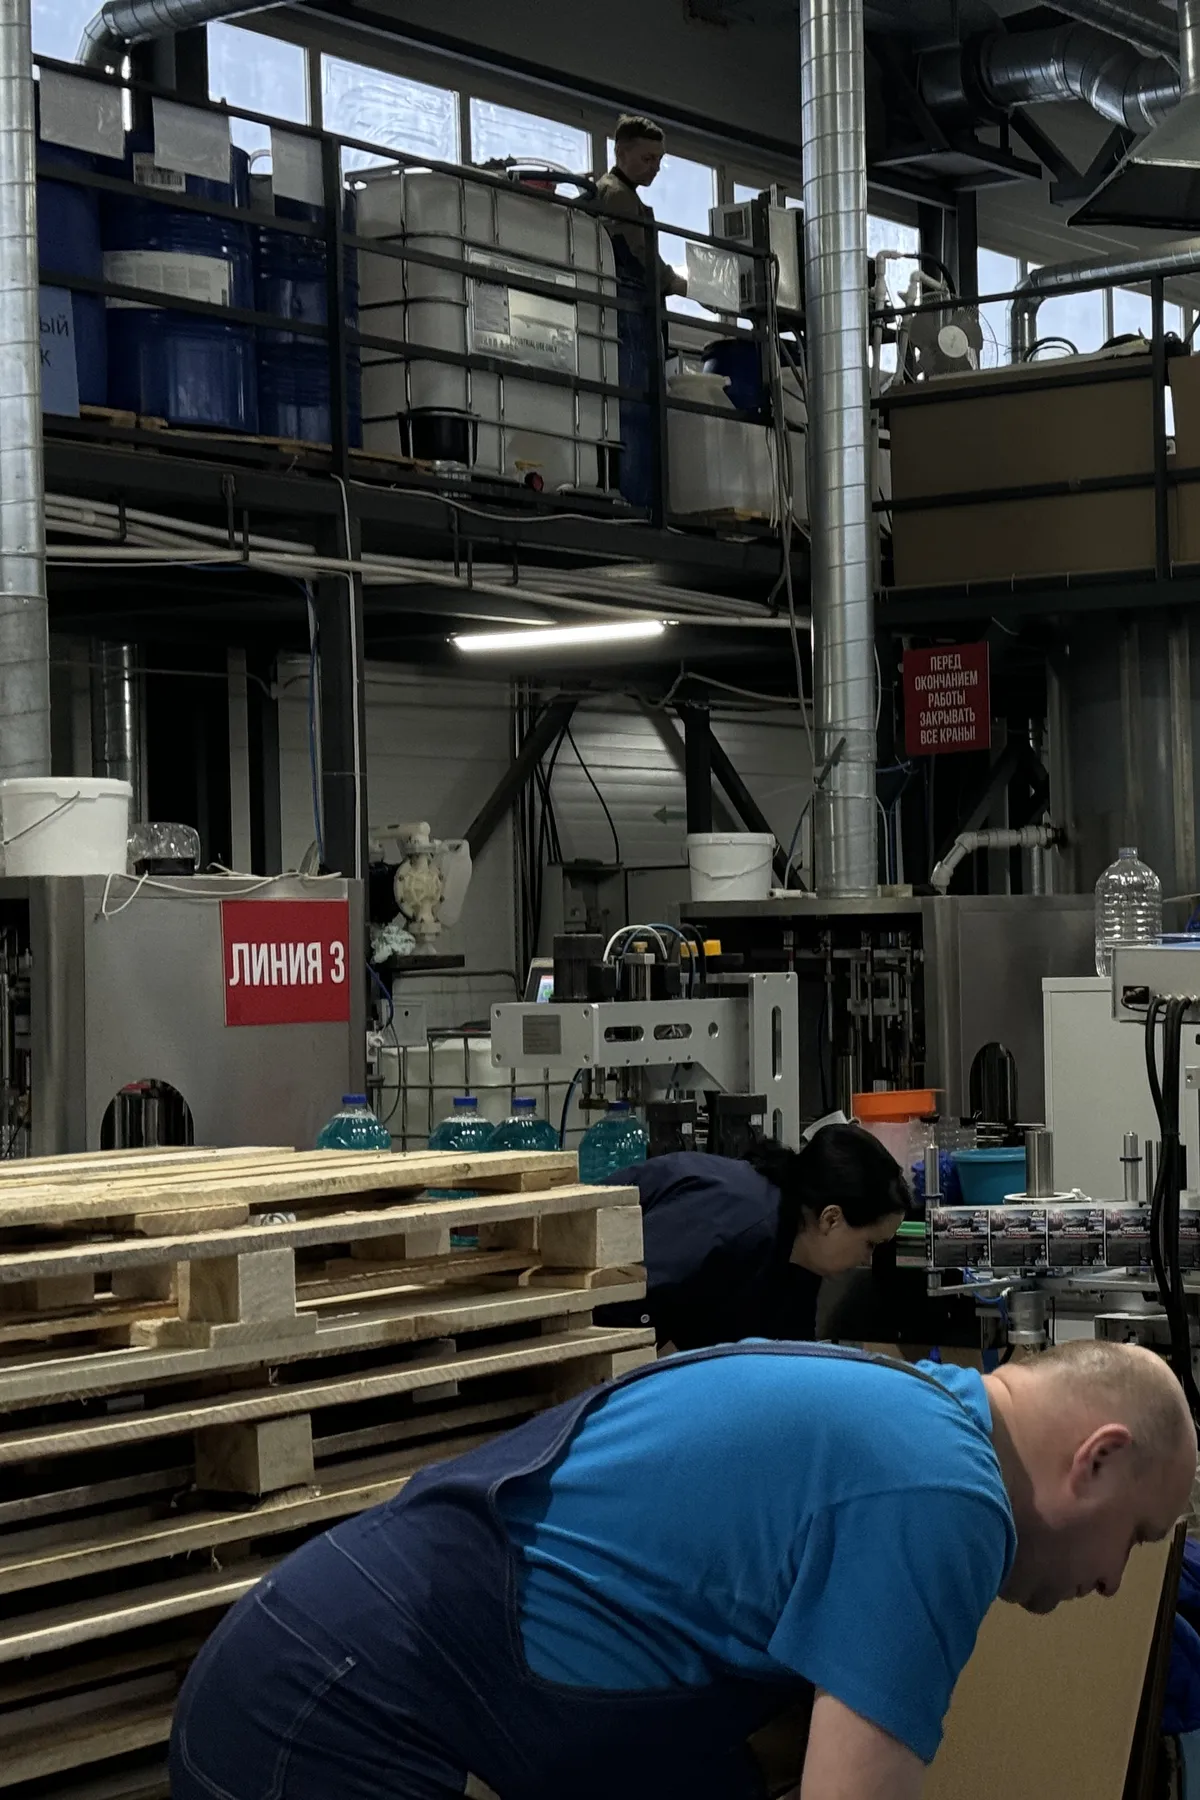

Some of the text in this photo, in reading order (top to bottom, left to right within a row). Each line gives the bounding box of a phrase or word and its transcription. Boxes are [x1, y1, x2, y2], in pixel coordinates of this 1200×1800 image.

[930, 653, 962, 671] ПЕРЕД
[914, 670, 978, 691] ОКОНЧАНИЕМ
[928, 690, 966, 708] РАБОТЫ
[920, 707, 976, 727] ЗАКРЫВАТЬ
[920, 725, 976, 745] ВСЕ КРАНЫ!
[229, 941, 345, 986] ЛИНИЯ 3
